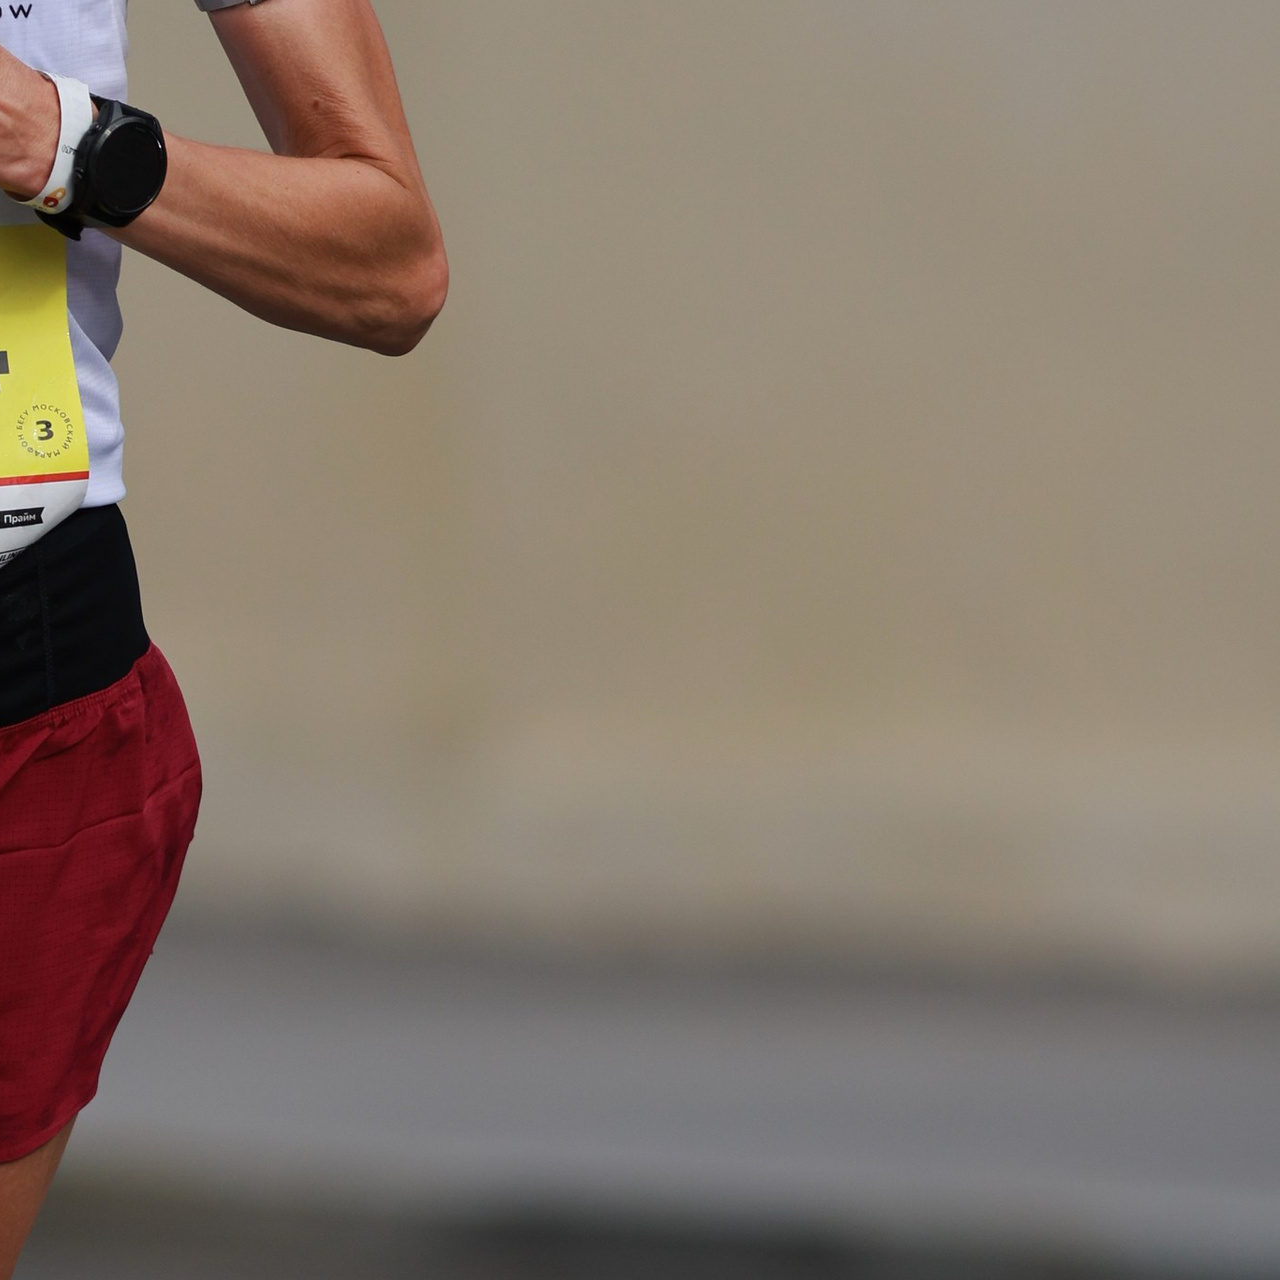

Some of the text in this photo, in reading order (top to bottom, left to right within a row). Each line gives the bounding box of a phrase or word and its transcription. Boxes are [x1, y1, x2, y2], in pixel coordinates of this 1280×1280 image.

[32, 403, 74, 450] МОСКОВСКИЙ
[35, 419, 54, 441] 3
[4, 512, 36, 524] Прайм
